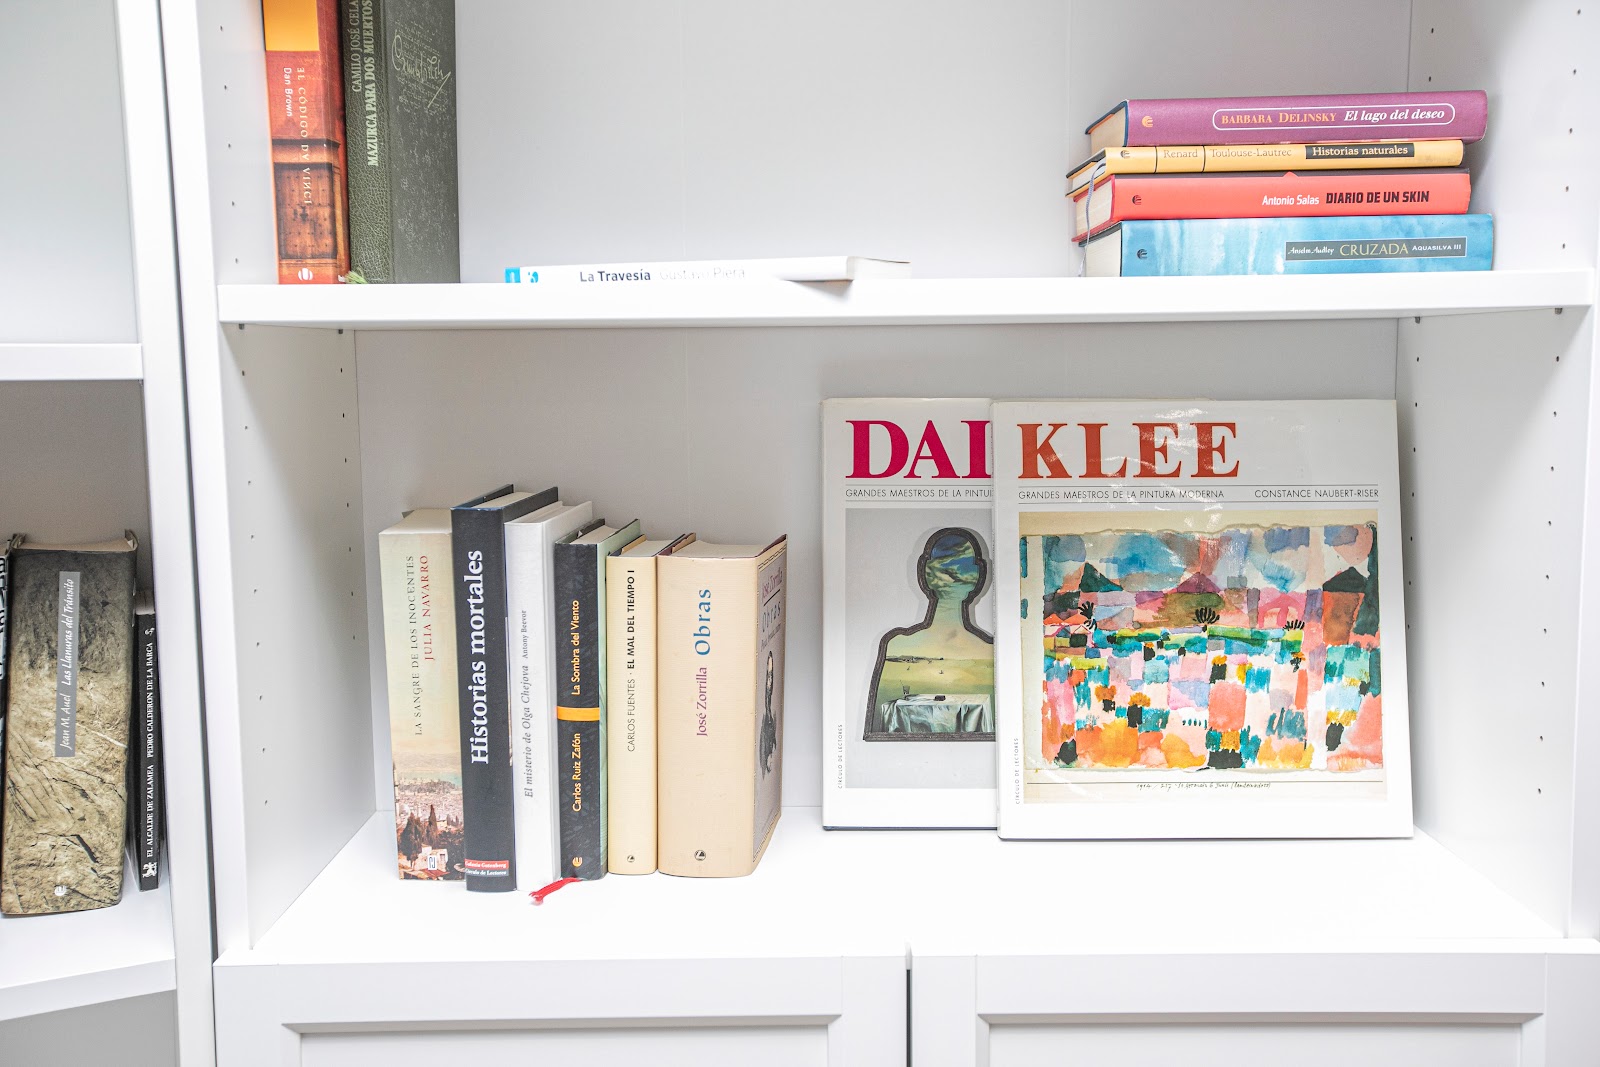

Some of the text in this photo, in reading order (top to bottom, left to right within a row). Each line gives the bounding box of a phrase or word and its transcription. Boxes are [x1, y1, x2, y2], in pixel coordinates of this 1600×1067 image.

[347, 0, 362, 92] CAMILO JOSÉ CELA
[283, 67, 293, 117] Dan Brown
[362, 0, 379, 166] MAZURCA PARA DOS MUERTOS
[298, 87, 309, 138] CÓDIGO
[1221, 108, 1445, 125] BARBARA DELINSKY El lago del deseo
[301, 144, 310, 161] DA
[1163, 145, 1408, 159] Renard Toulouse-Lautrec Historias naturales
[1261, 190, 1430, 206] Antonio Salas DIARIO DE UN SKIN
[1339, 243, 1409, 256] CRUZADA
[579, 271, 595, 282] La
[597, 269, 651, 282] Travesía
[1016, 422, 1240, 479] KLEE
[845, 489, 993, 498] GRANDES MAESTROS DE LA PINTU
[1018, 489, 1225, 499] GRANDES MAESTROS DE LA PINTURA MODERNA
[1254, 489, 1379, 498] CONSTANCE NAUBERT-RISER
[626, 576, 635, 613] TIEMPO
[419, 555, 435, 661] JULIA NAVARRO
[626, 615, 635, 633] DEL
[145, 642, 153, 667] BARCA
[406, 555, 423, 736] LA SANGRE DE LOS INOCENTES
[463, 549, 489, 764] Historias mortales
[626, 636, 635, 656] MAL
[59, 578, 75, 751] Jean M. Auel Las Llanuras del Tránsito
[146, 667, 154, 678] LA
[626, 659, 635, 669] EL
[692, 589, 712, 737] José Zorrilla Obras
[146, 679, 154, 691] DE
[627, 678, 636, 716] FUENTES
[520, 610, 533, 797] El misterio de Olga Chejova Antony Beevor
[570, 600, 582, 812] Carlos Ruiz Zafón La Sombra del Viento
[146, 732, 155, 758] PEDRO
[627, 718, 636, 752] CARLOS
[146, 764, 154, 800] ZALAMEA
[1014, 769, 1020, 777] DE
[146, 800, 154, 812] DE
[146, 812, 154, 846] ALCALDE
[146, 847, 154, 858] EL
